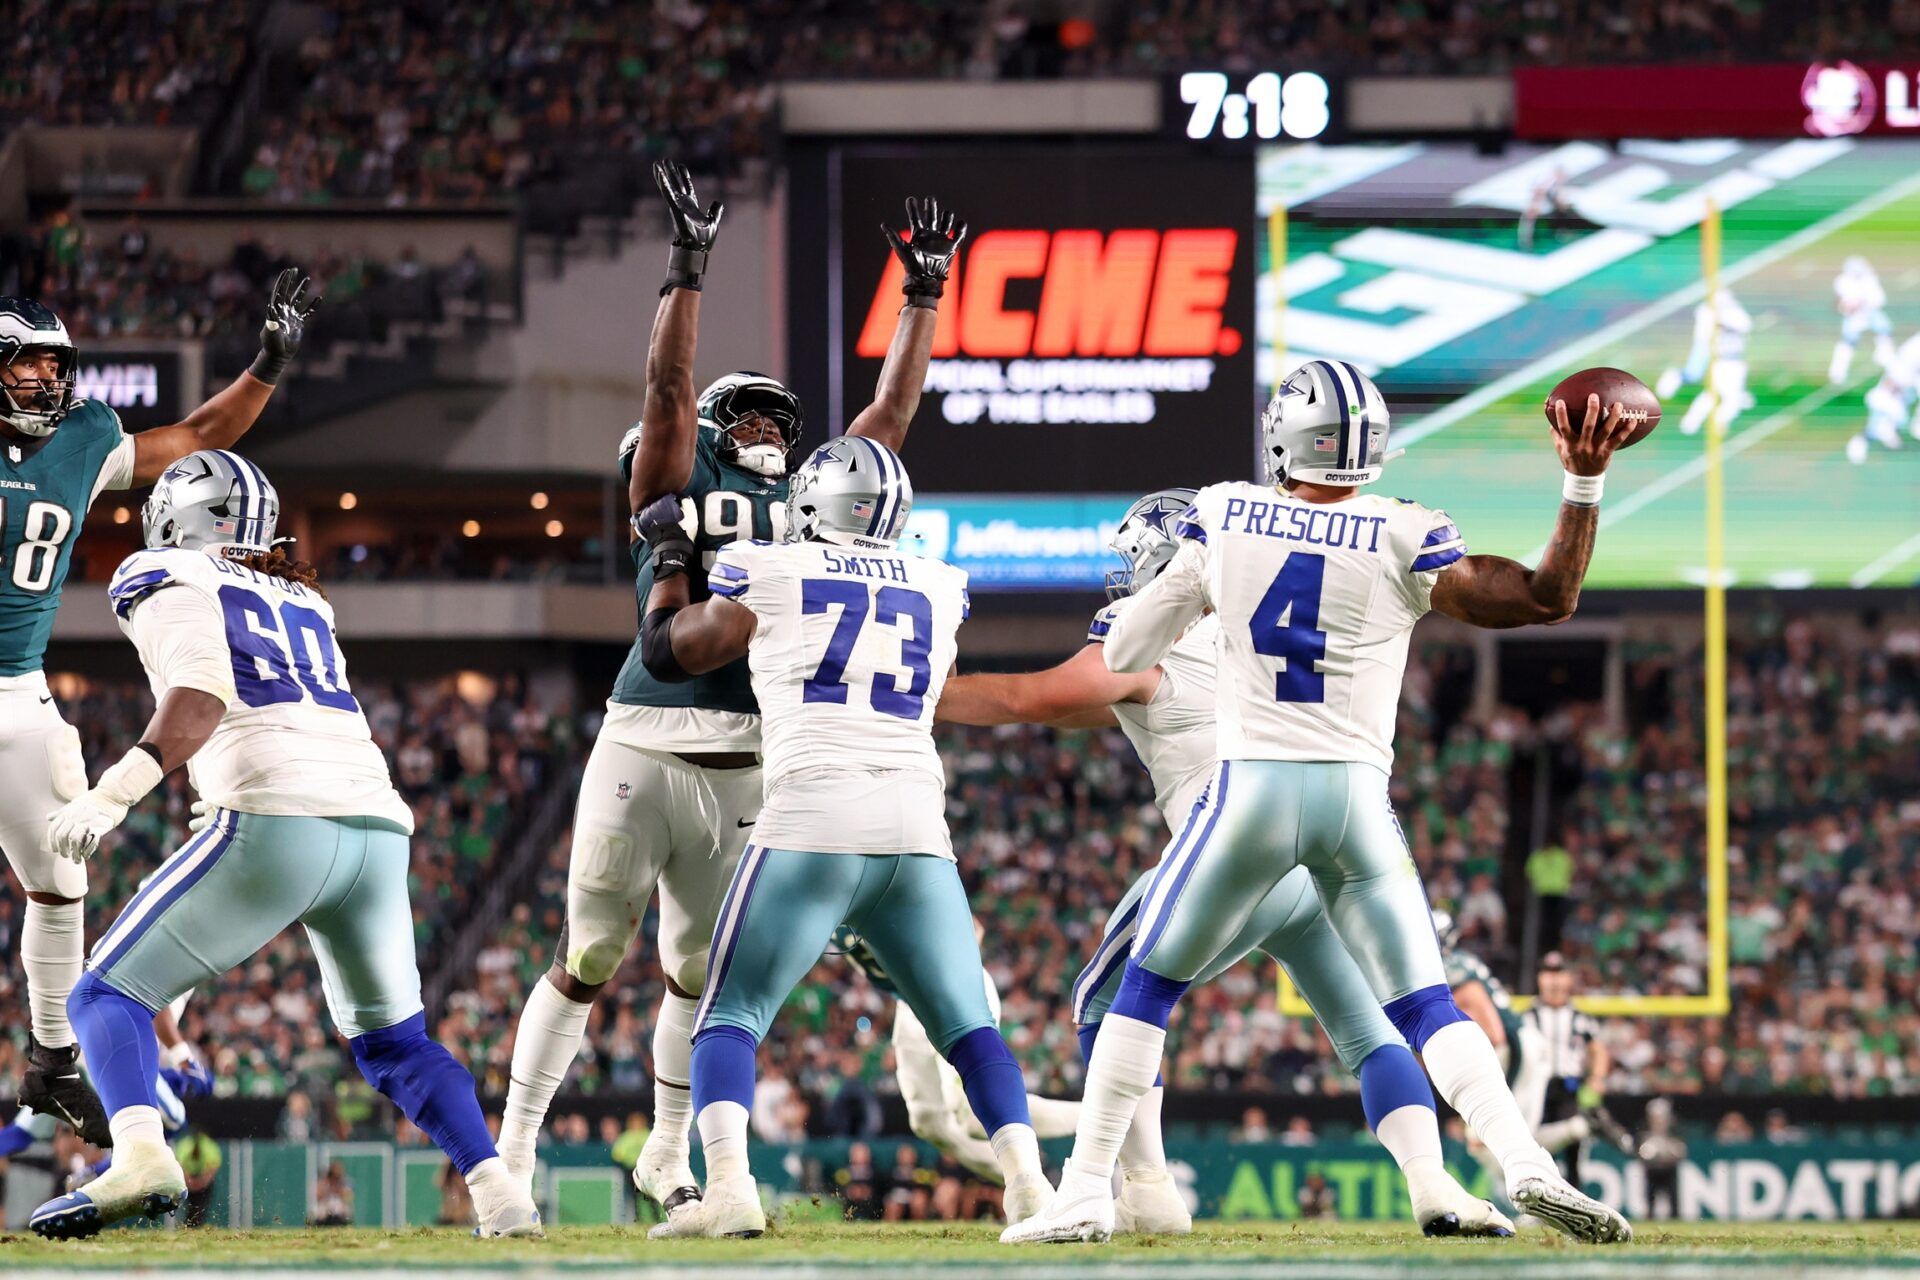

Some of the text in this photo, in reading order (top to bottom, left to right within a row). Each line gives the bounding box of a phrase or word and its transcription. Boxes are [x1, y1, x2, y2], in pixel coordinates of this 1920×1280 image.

[1180, 72, 1329, 139] 7:18
[1885, 70, 1920, 127] L
[1008, 359, 1213, 392] SUPERMARKET
[1044, 391, 1156, 424] EAGLES
[0, 480, 36, 491] EAGLES
[1325, 473, 1370, 481] COWBOYS
[0, 497, 72, 592] 8
[701, 491, 788, 572] 9
[1221, 498, 1386, 552] PRESCOTT
[823, 550, 908, 583] SMITH
[217, 584, 360, 714] 60
[802, 579, 932, 720] 73
[1249, 551, 1326, 703] 4
